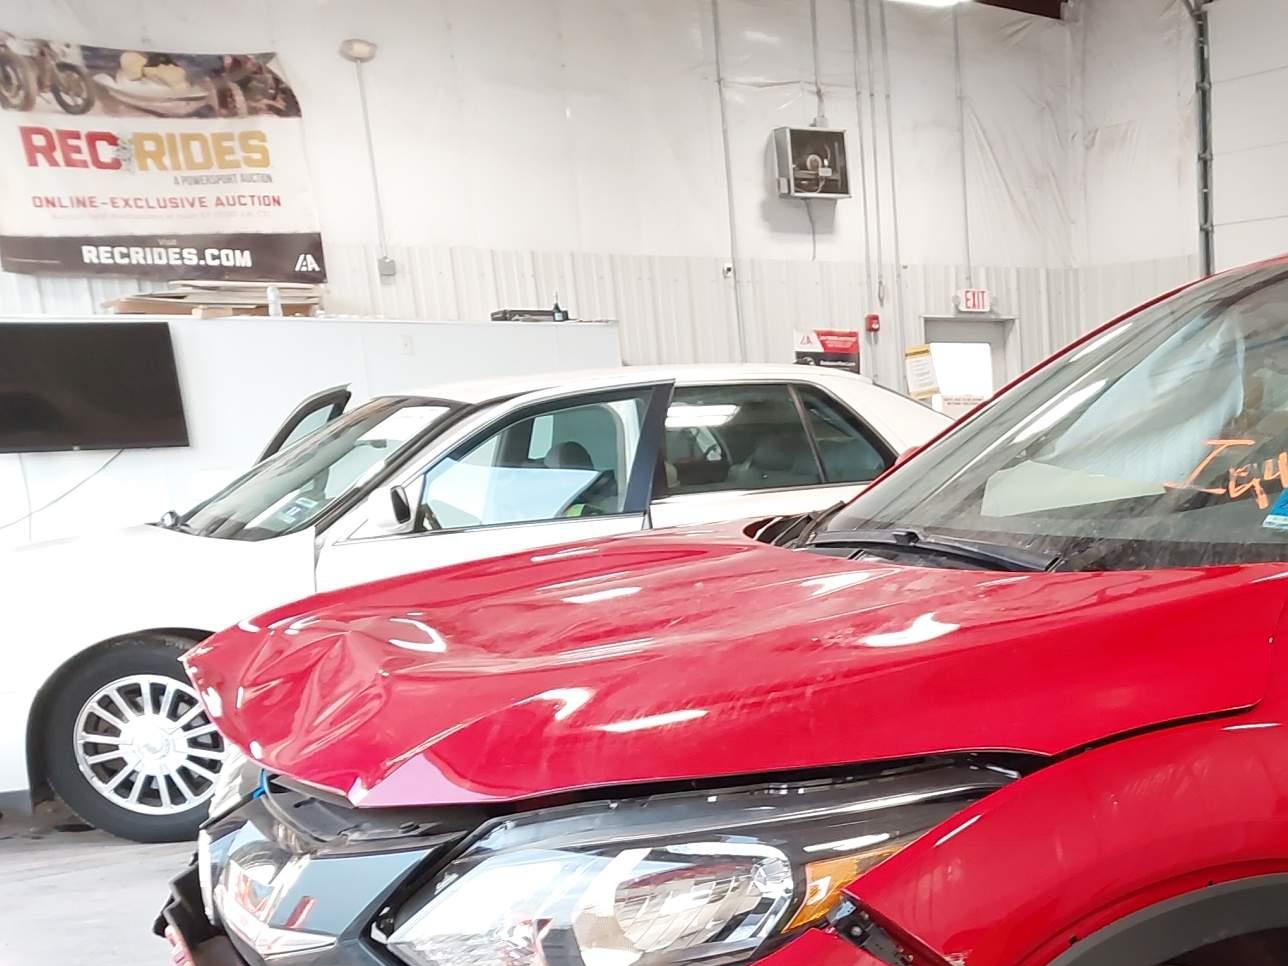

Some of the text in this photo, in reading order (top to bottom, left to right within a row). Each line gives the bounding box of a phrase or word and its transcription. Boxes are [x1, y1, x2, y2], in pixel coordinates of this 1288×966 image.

[18, 125, 271, 171] REC RIDES
[31, 194, 282, 209] ONLINE-EXCLUSIVE AUCTION
[81, 245, 252, 267] RECRIDES.COM
[965, 290, 986, 309] EXIT
